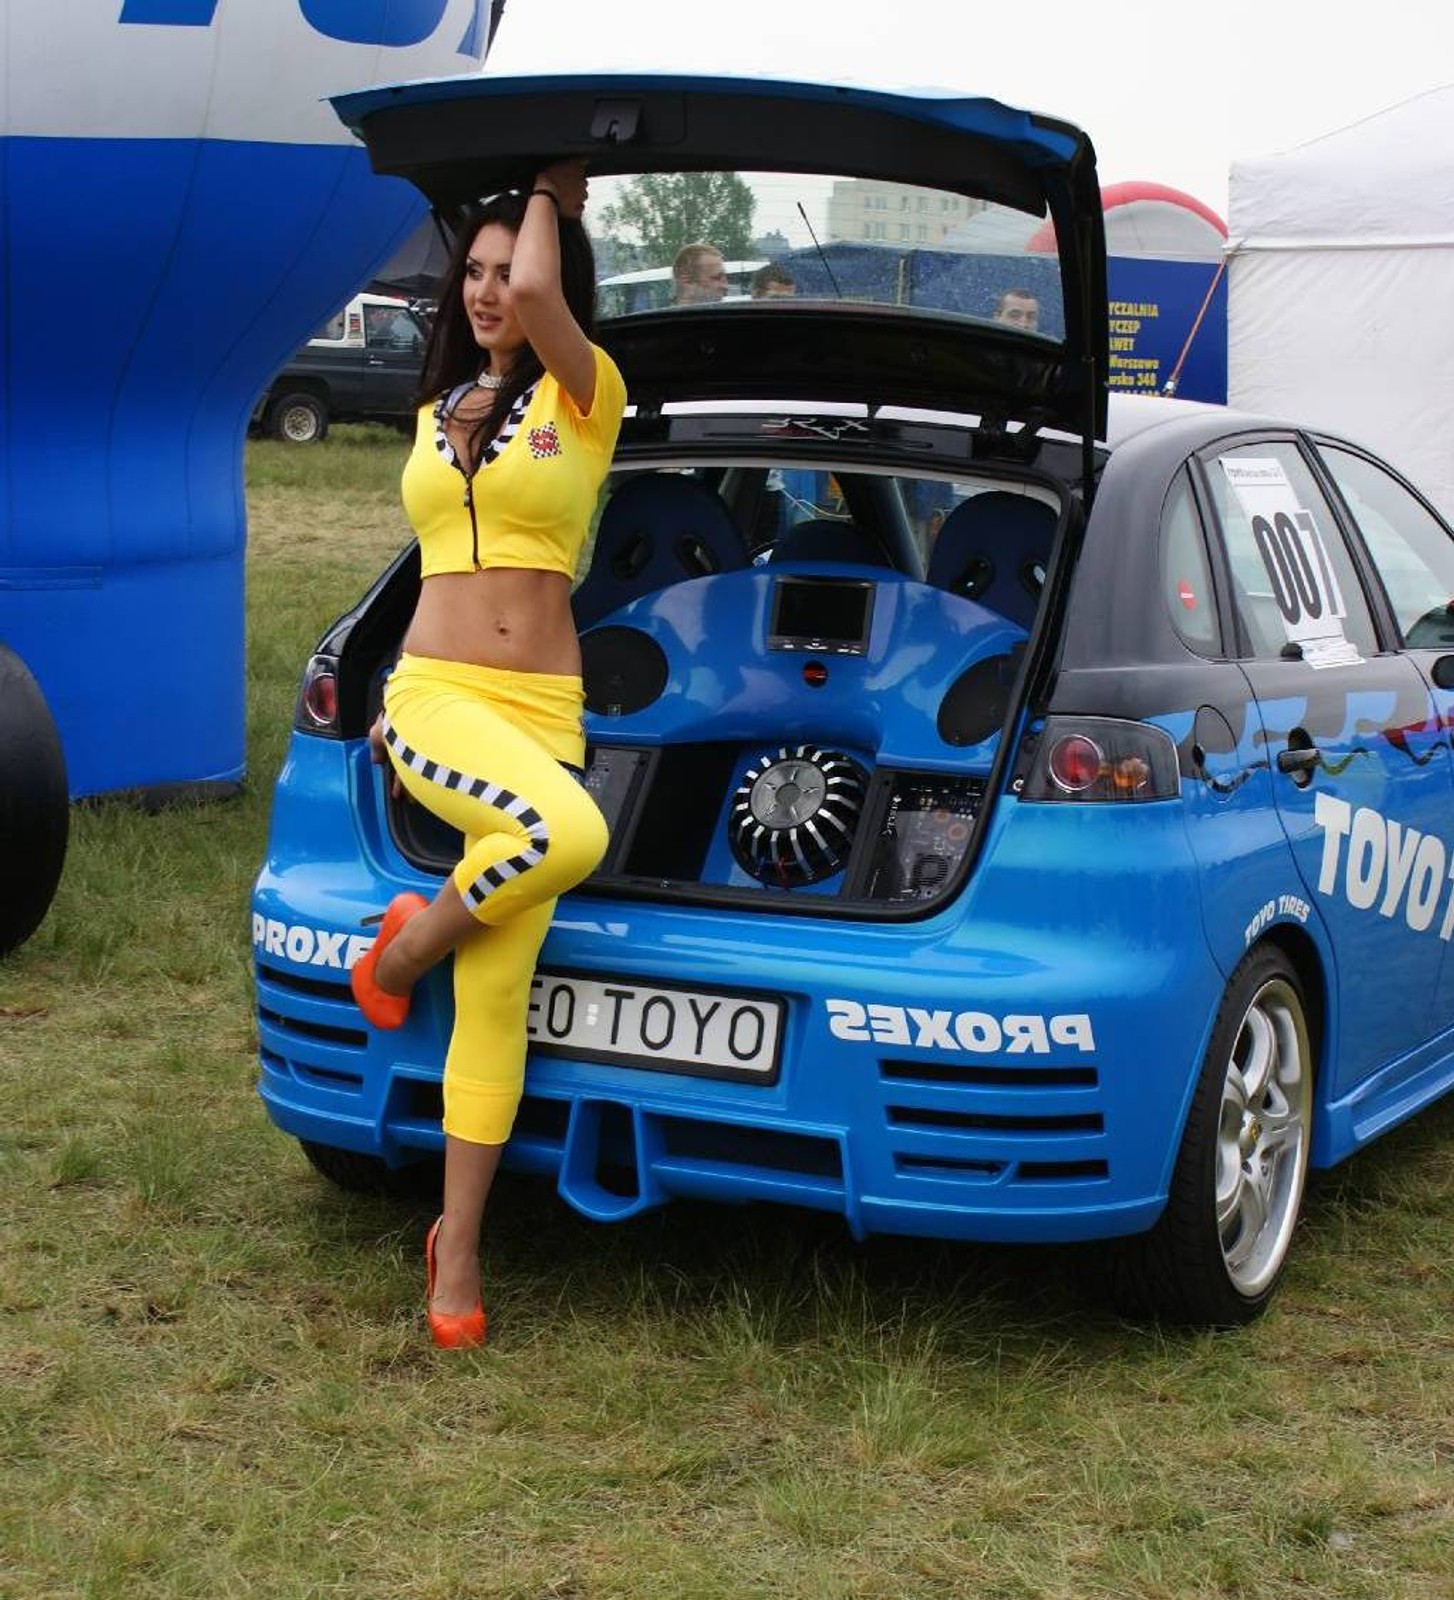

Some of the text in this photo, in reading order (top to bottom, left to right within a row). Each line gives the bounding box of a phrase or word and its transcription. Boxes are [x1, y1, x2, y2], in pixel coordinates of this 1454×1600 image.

[1108, 302, 1158, 317] YCZALNIA
[1108, 320, 1140, 334] YCZEP
[1252, 512, 1340, 625] 007
[1315, 792, 1445, 932] TOYO
[253, 912, 377, 970] PROXE
[1245, 894, 1310, 949] TOYO TIRES
[604, 988, 765, 1061] TOYO
